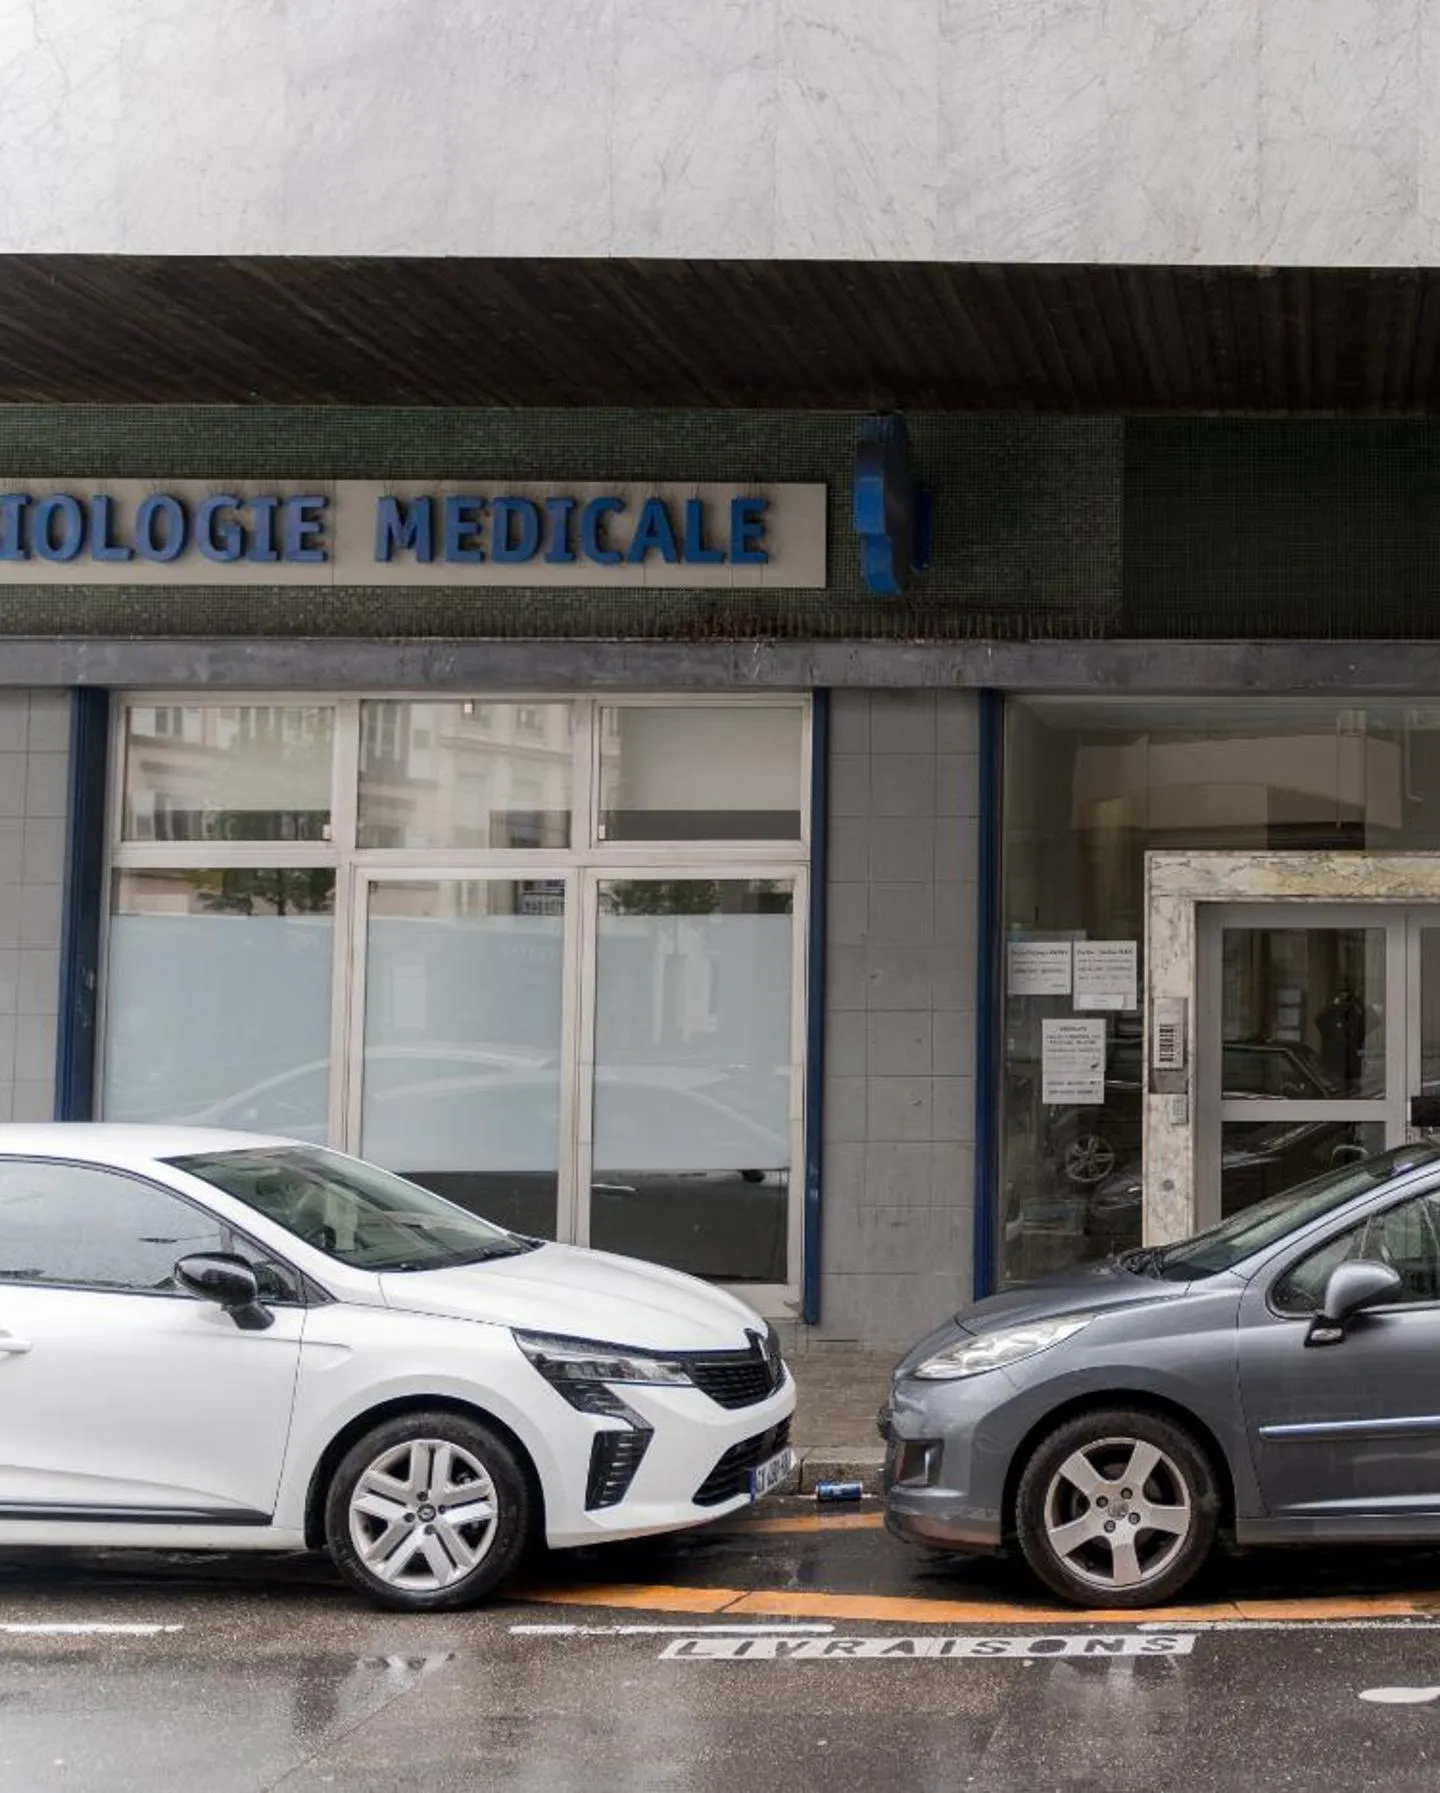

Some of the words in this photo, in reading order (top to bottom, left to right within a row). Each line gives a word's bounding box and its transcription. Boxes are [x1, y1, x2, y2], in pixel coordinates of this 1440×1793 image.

[0, 493, 328, 563] IOLOGIE
[374, 495, 769, 565] MEDICALE
[674, 1637, 1180, 1657] LIVRAISONS
